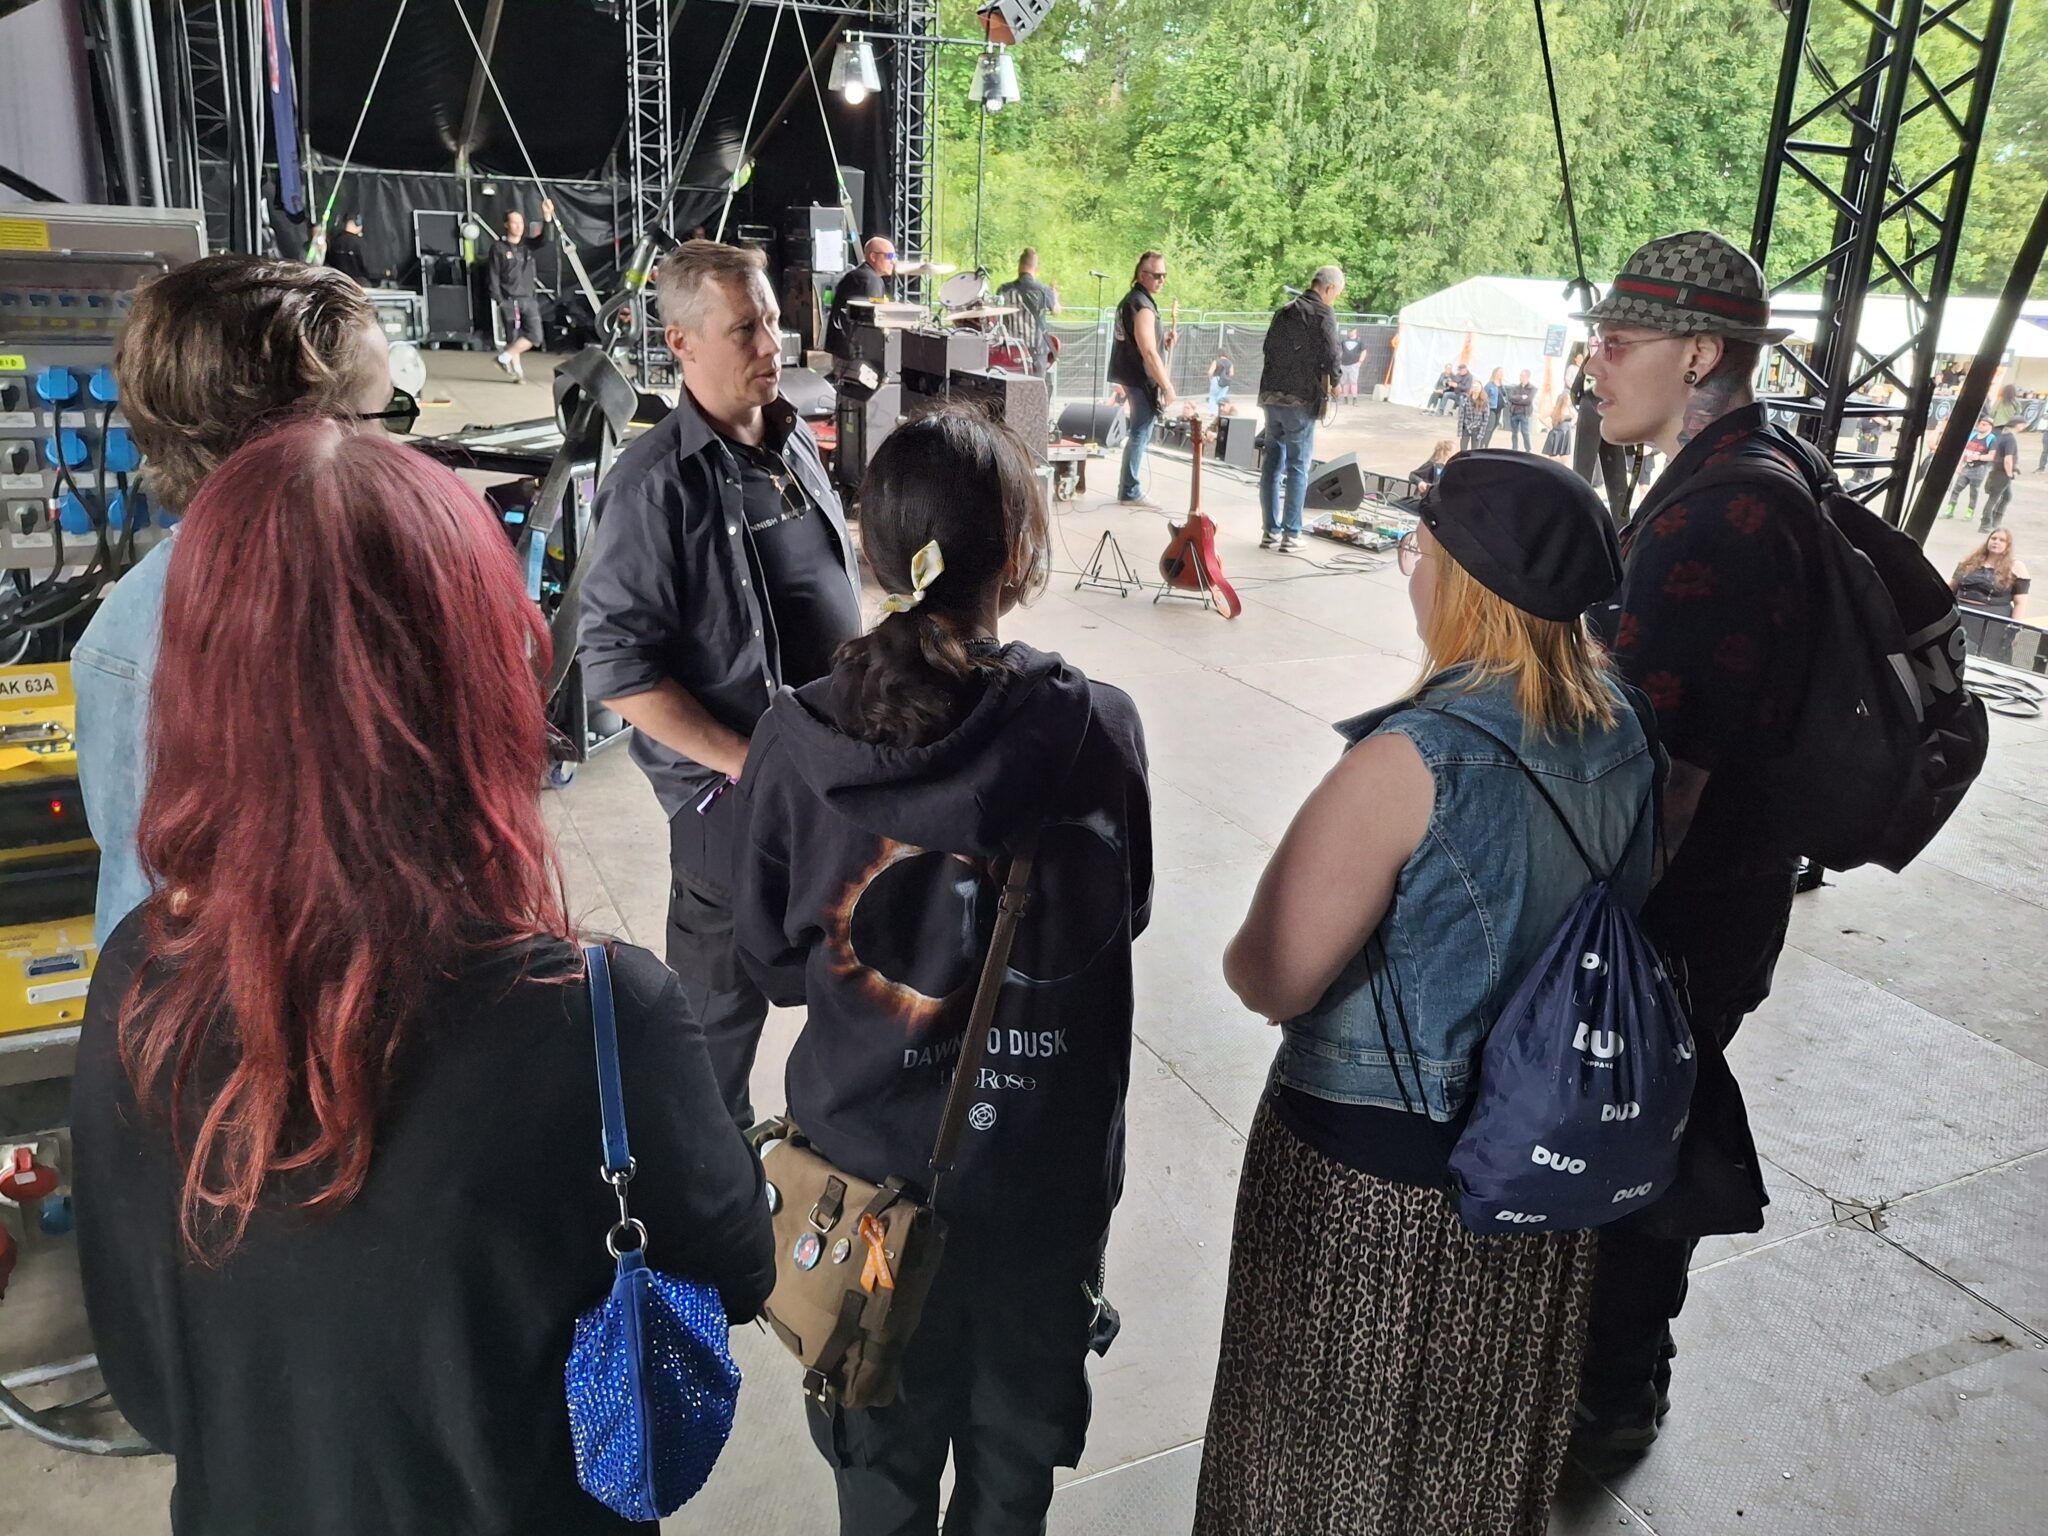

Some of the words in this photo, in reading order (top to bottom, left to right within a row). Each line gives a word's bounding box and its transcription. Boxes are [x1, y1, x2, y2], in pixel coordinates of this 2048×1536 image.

[25, 678, 55, 693] 63A
[1009, 1028, 1069, 1059] DUSK
[1531, 1144, 1587, 1175] DUO
[1611, 1181, 1653, 1204] DUO
[1495, 1210, 1548, 1224] DUO
